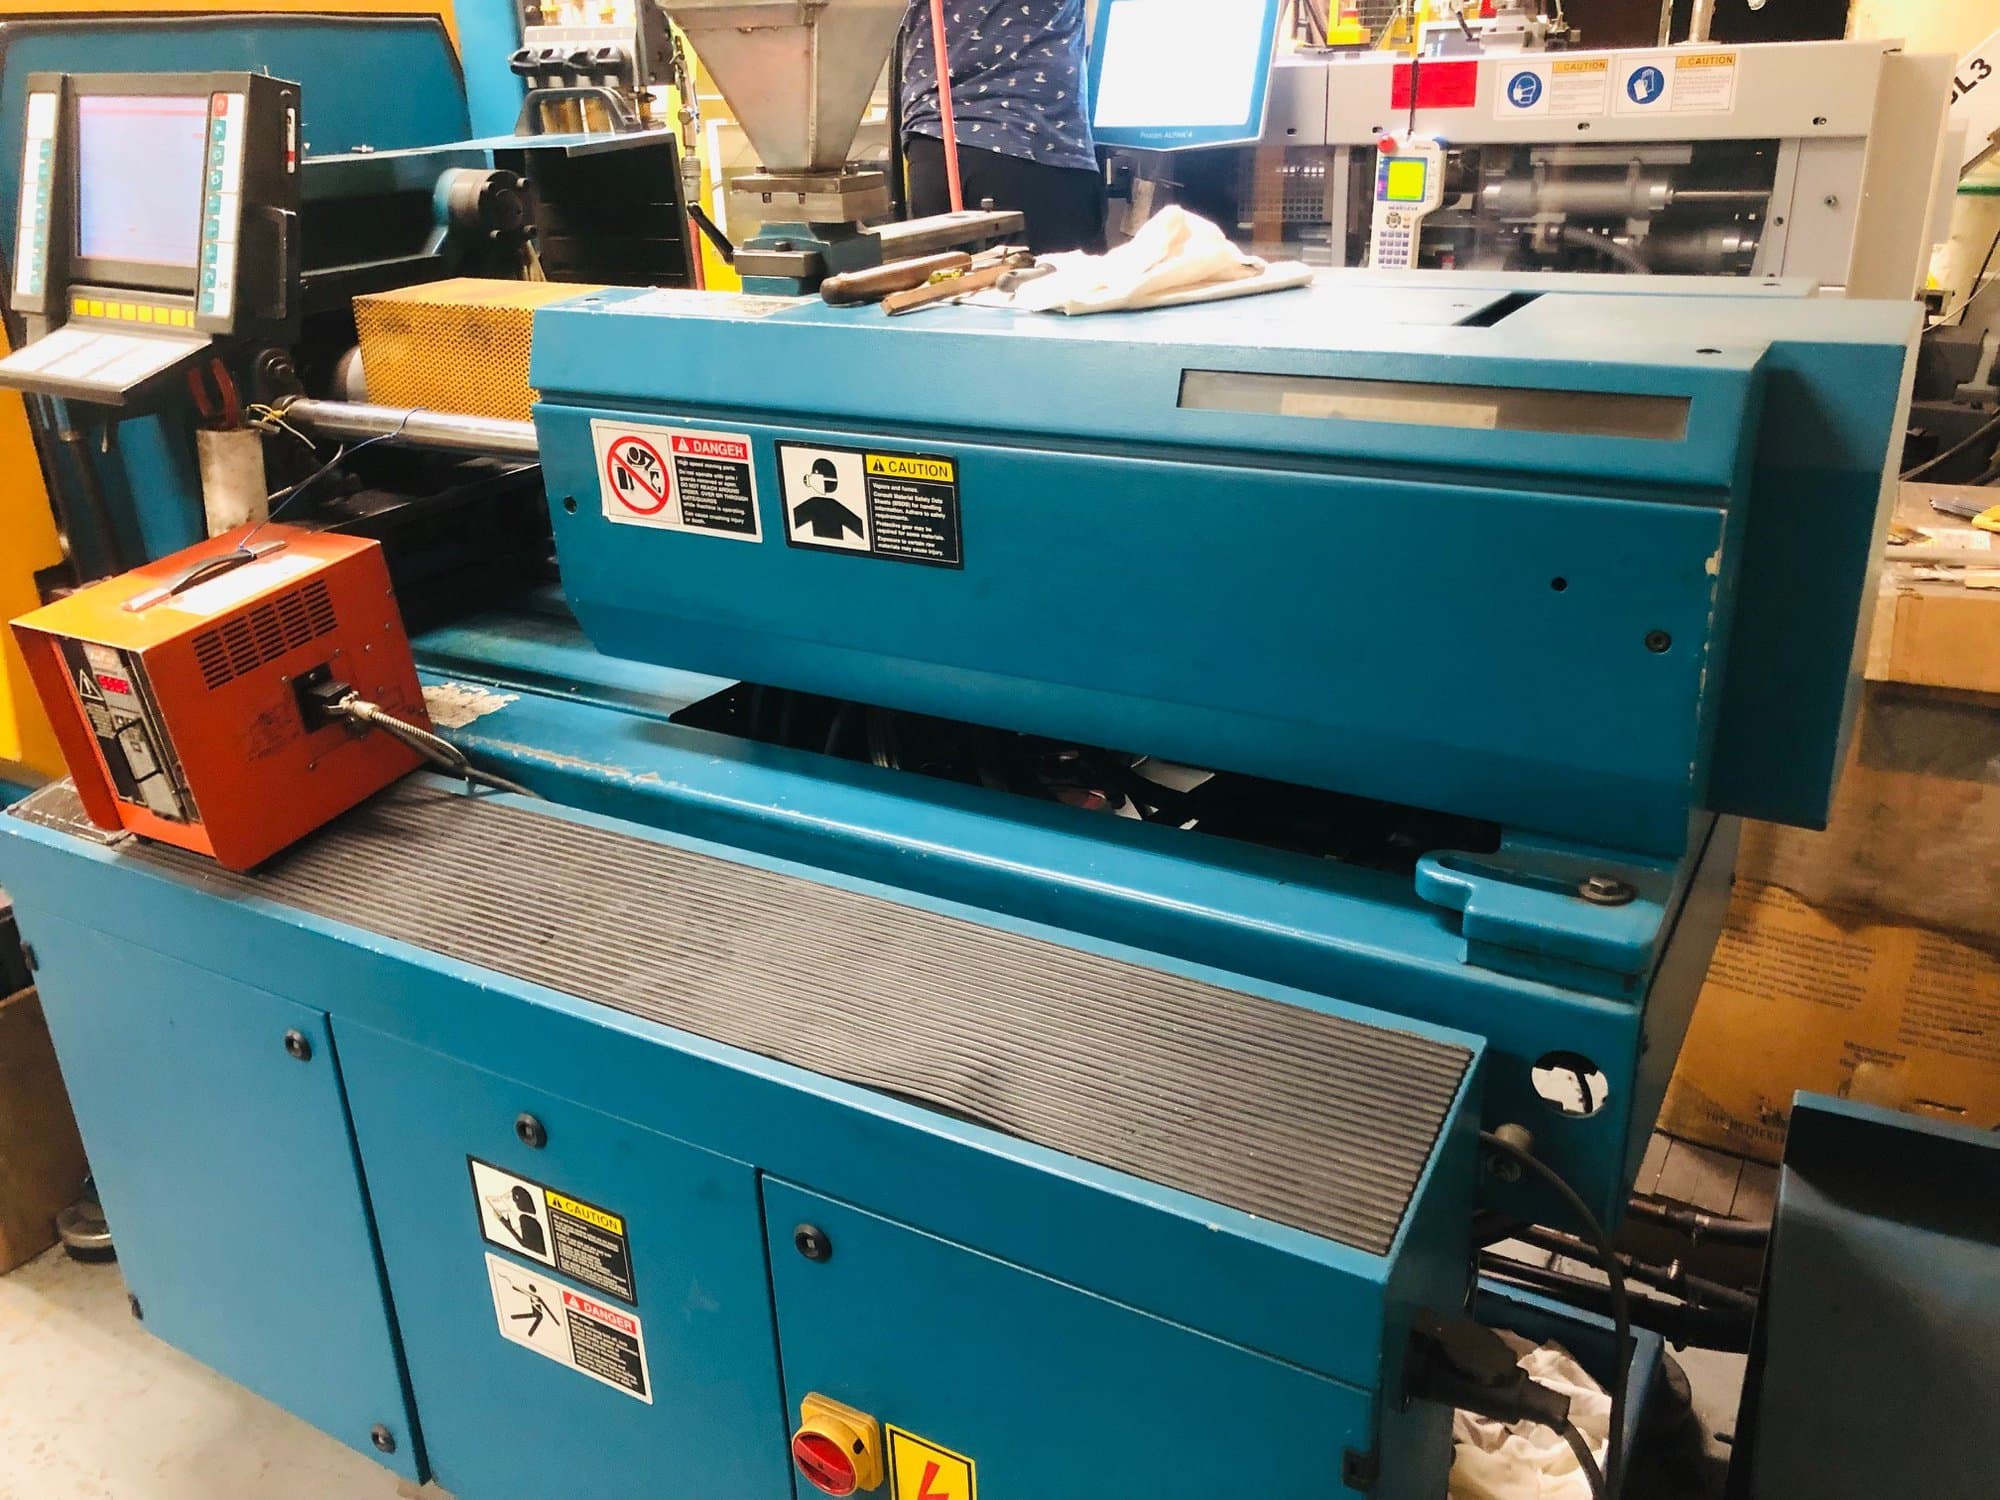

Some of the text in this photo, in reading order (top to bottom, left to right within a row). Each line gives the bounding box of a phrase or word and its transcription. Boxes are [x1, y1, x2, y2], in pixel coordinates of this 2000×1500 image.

[1564, 61, 1606, 72] CAUTION
[1688, 56, 1734, 66] CAUTION
[693, 440, 744, 458] DANGER
[888, 460, 948, 478] CAUTION
[565, 1202, 617, 1230] CAUTION
[583, 1302, 633, 1331] DANGER
